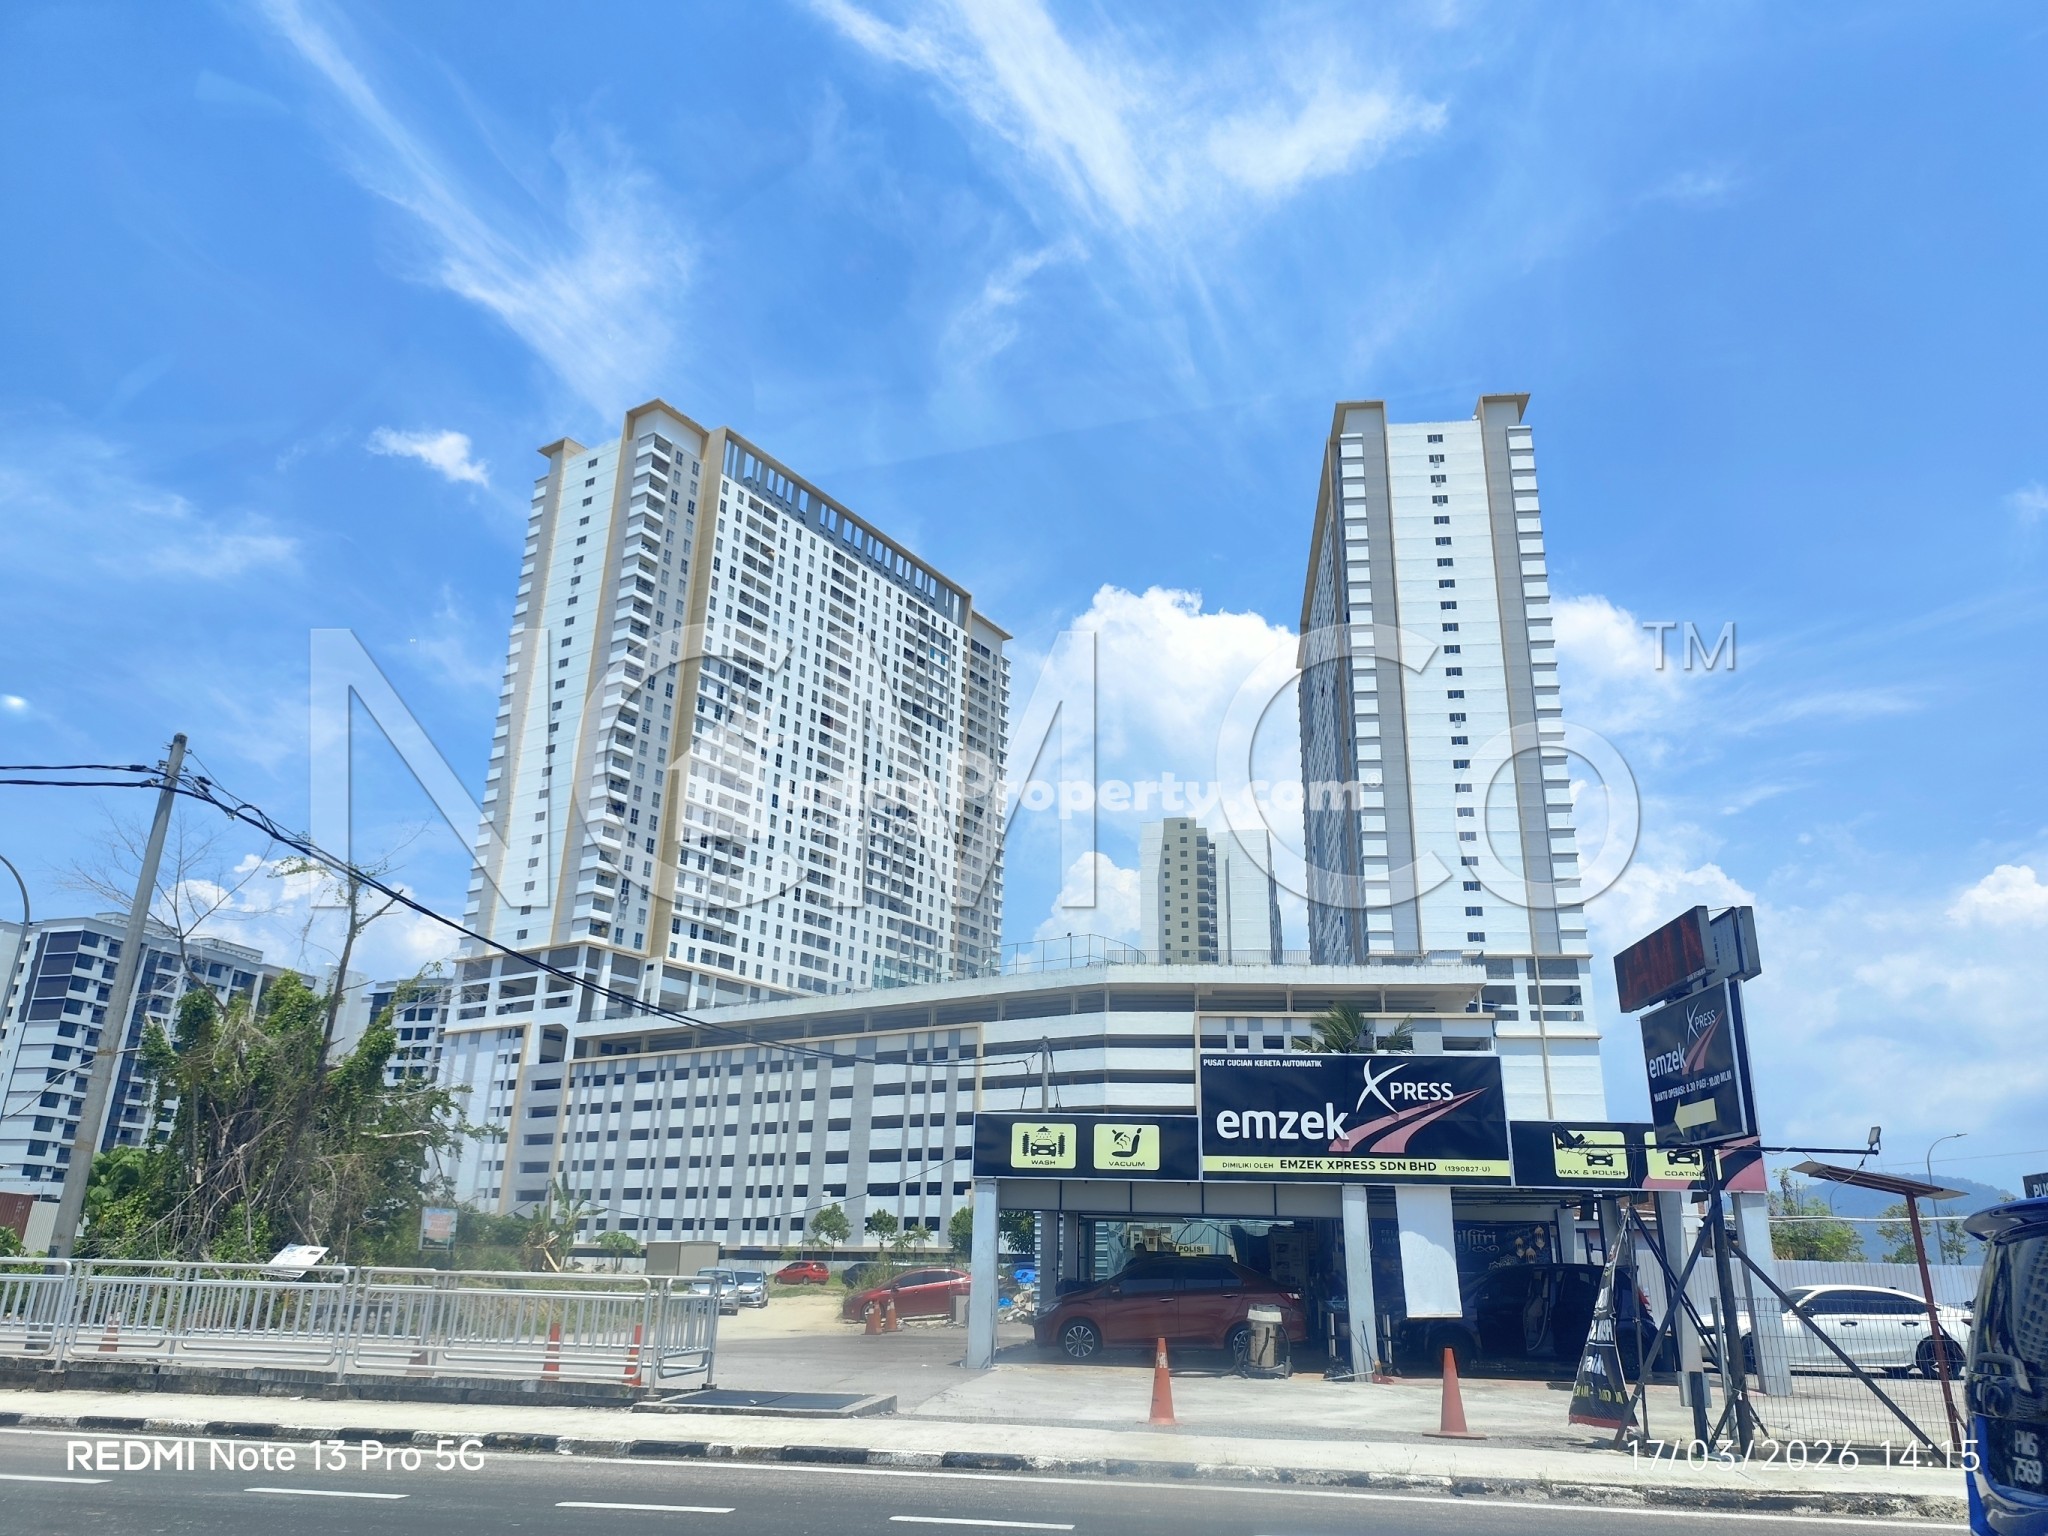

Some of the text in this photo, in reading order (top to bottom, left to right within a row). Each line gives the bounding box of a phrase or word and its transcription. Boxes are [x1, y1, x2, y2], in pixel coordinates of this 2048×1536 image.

[1685, 1002, 1717, 1045] XPRESS
[1203, 1058, 1323, 1068] PUSAT CUCIAN KERETA AUTOMATIK
[1648, 1042, 1687, 1079] emzek
[1356, 1058, 1454, 1113] XPRESS
[1216, 1102, 1350, 1141] emzek
[1222, 1161, 1252, 1169] DIMILIKI
[1279, 1159, 1324, 1171] EMZEK
[1326, 1159, 1376, 1171] XPRESS
[1379, 1161, 1407, 1172] SDN
[1409, 1161, 1437, 1172] BHD
[1444, 1164, 1491, 1173] (1390827-U)
[1178, 1245, 1205, 1254] POLISI
